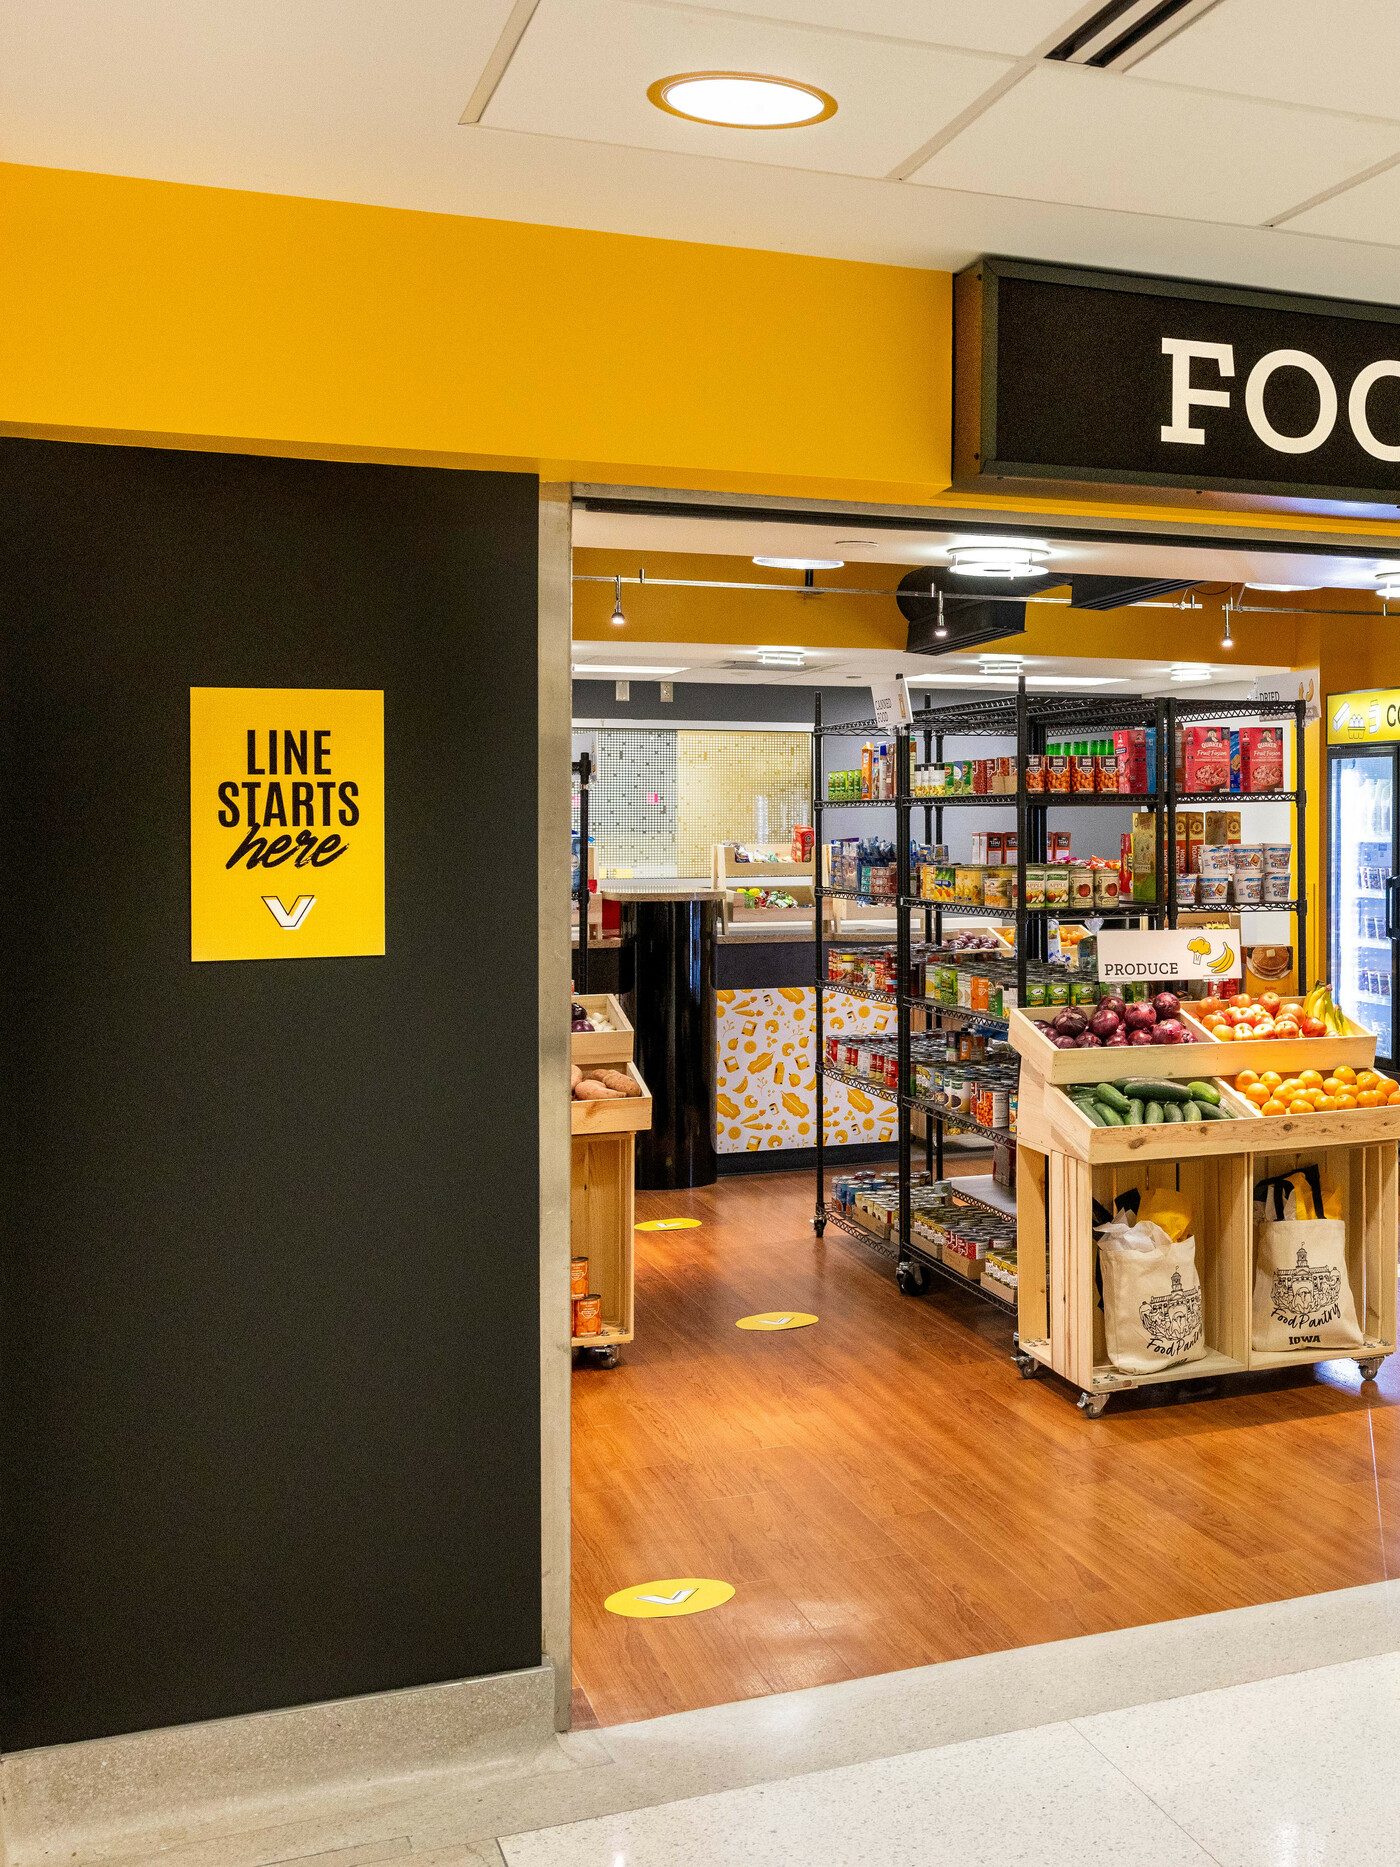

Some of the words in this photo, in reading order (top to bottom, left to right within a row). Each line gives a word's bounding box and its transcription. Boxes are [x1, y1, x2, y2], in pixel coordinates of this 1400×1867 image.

[1259, 691, 1280, 701] DRIED
[877, 711, 889, 723] FOOD
[247, 730, 332, 775] LINE
[217, 780, 360, 827] STARTS
[225, 822, 350, 870] here
[1104, 962, 1179, 976] PRODUCE
[1270, 1306, 1298, 1329] Food
[1298, 1302, 1341, 1329] Pantry
[1146, 1338, 1176, 1357] Food
[1288, 1335, 1321, 1345] IOWA
